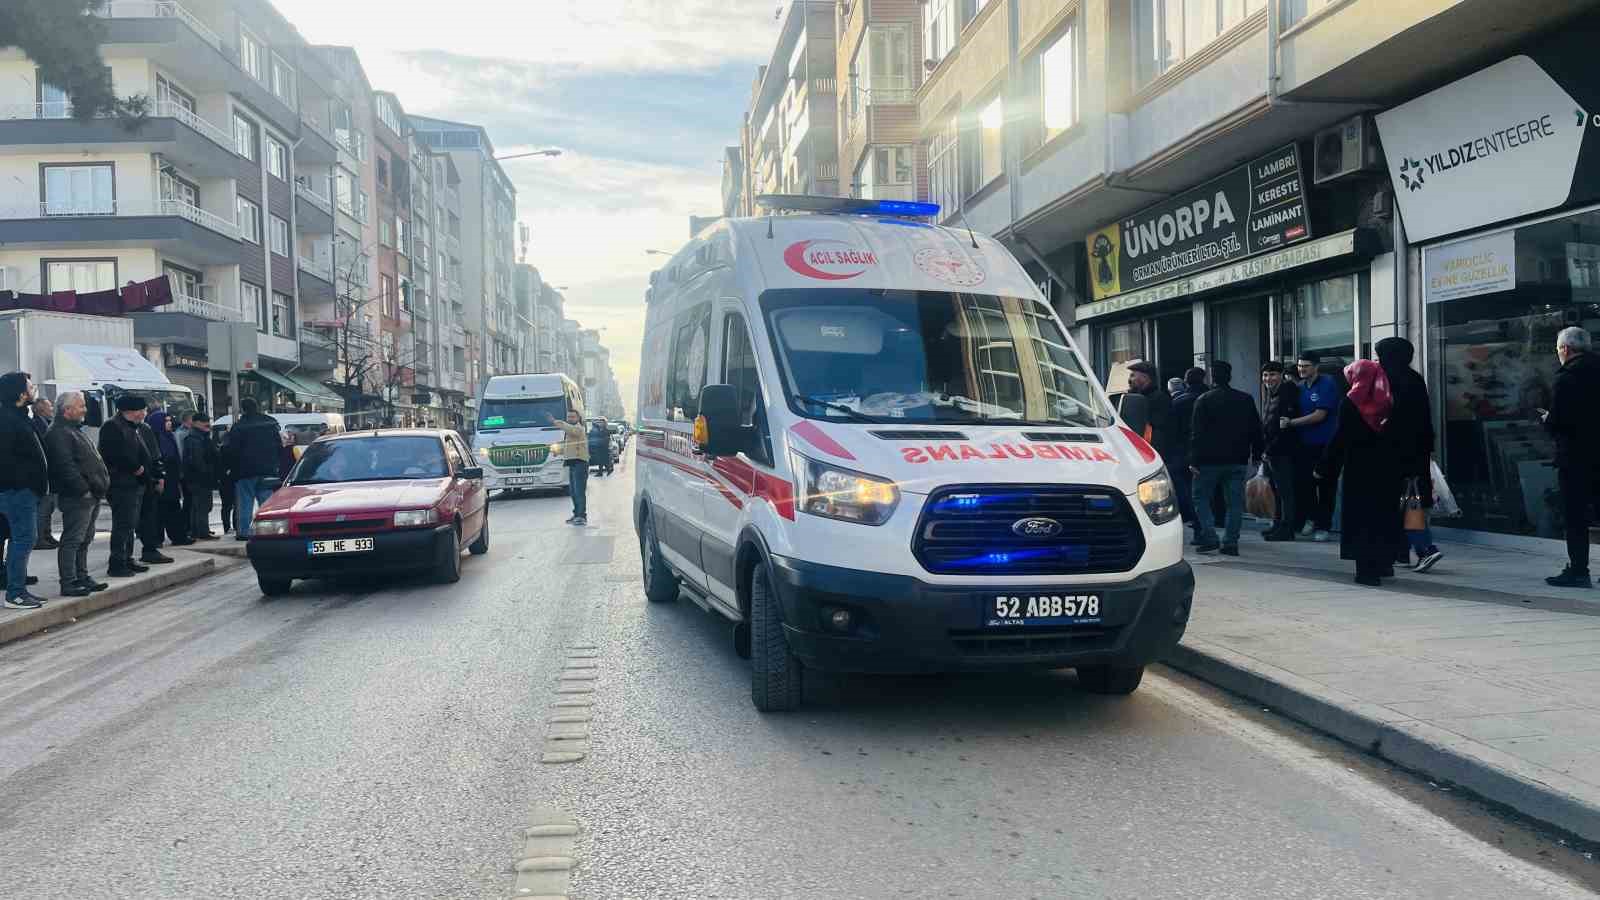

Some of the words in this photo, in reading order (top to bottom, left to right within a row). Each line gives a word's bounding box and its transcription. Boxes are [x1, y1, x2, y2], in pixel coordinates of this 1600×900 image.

[1425, 114, 1554, 174] YILDIZENTEGRE
[1258, 180, 1299, 204] KERESTE
[1124, 190, 1235, 258] ÜNORPA
[1132, 259, 1161, 282] ORMAN
[1024, 520, 1053, 535] Ford
[313, 542, 325, 553] 55
[333, 540, 345, 551] HE
[355, 539, 373, 550] 933
[996, 596, 1020, 618] 52
[1025, 596, 1063, 617] ABB
[1064, 595, 1099, 616] 578
